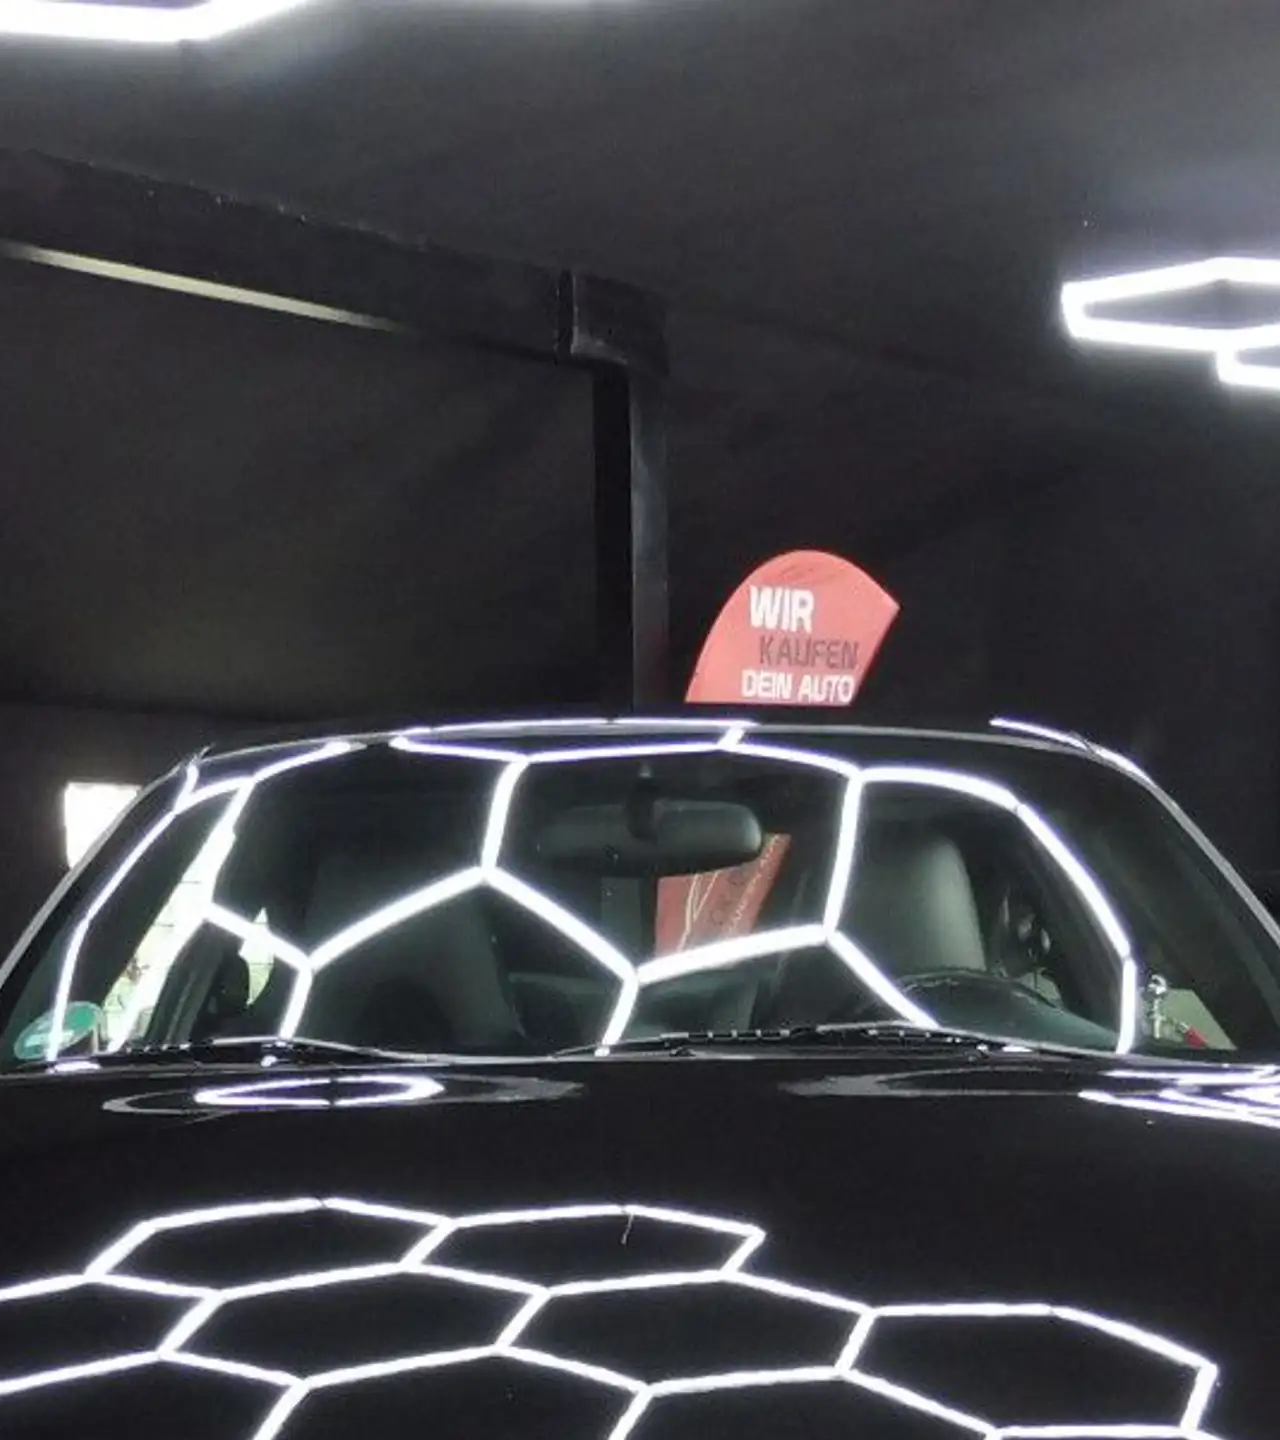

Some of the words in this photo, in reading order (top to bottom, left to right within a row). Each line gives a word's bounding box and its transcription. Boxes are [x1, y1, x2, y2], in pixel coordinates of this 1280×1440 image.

[749, 585, 815, 632] WIR
[759, 635, 860, 669] KAUFEN
[741, 669, 793, 699] DEIN
[796, 674, 855, 702] AUTO
